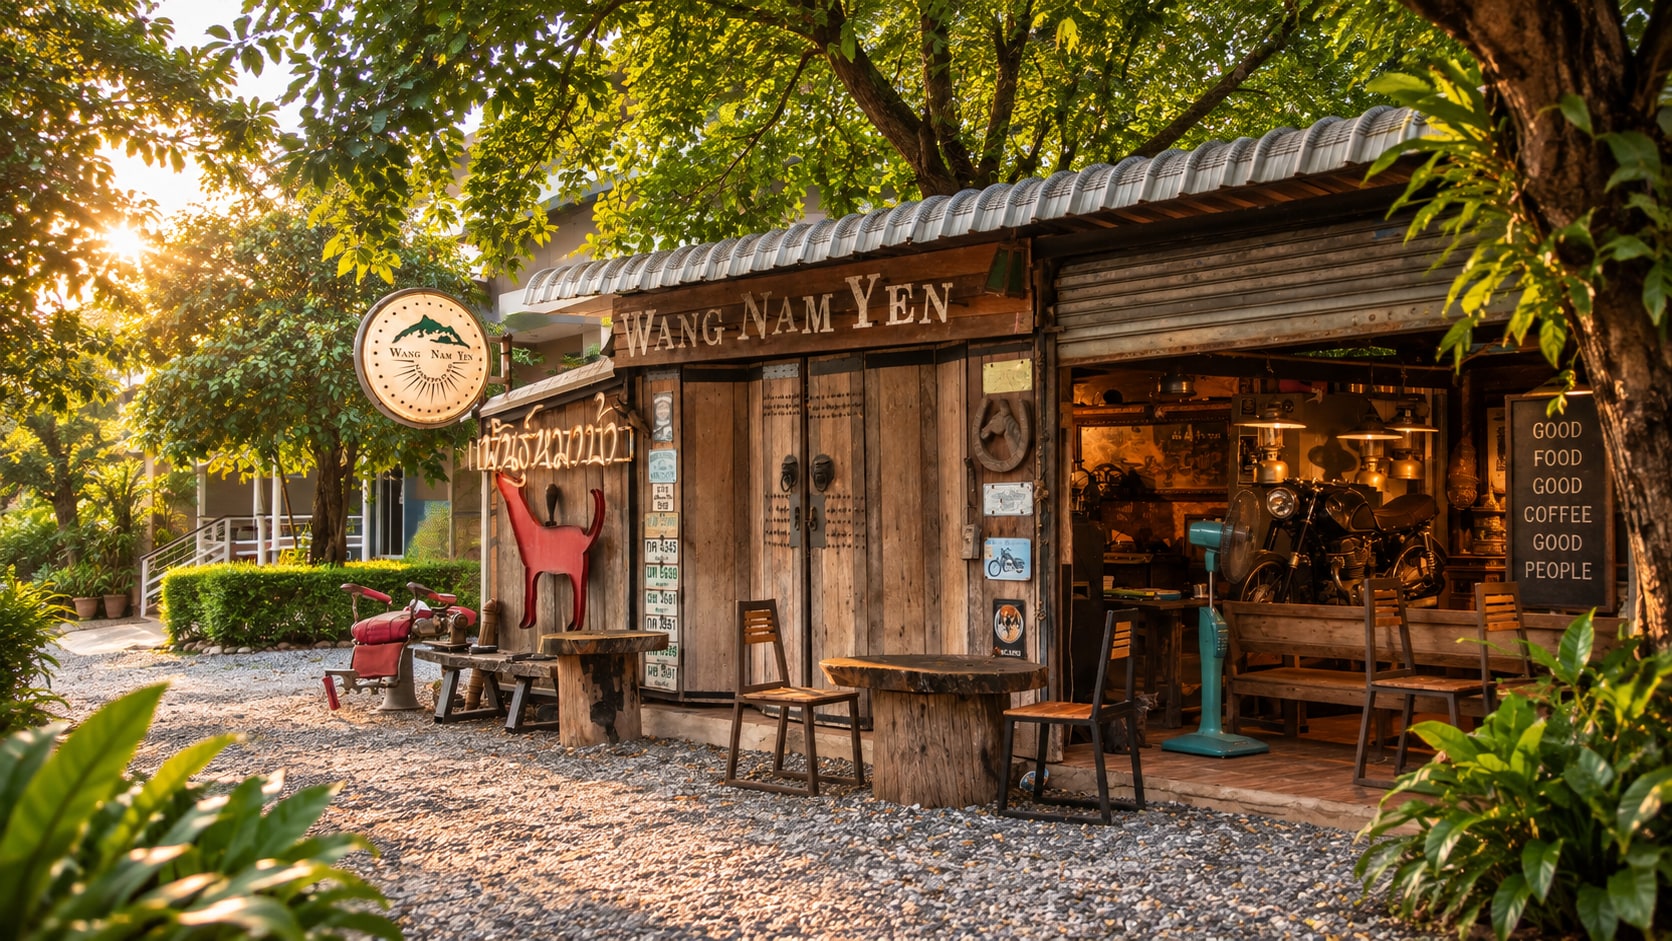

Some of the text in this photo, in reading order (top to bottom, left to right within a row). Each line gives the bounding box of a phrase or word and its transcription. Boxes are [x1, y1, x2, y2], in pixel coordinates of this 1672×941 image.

[1532, 421, 1583, 440] GOOD
[1534, 449, 1583, 467] FOOD
[1532, 477, 1583, 495] GOOD
[1524, 505, 1593, 524] COFFEE
[1532, 533, 1583, 551] GOOD
[1525, 561, 1593, 580] PEOPLE
